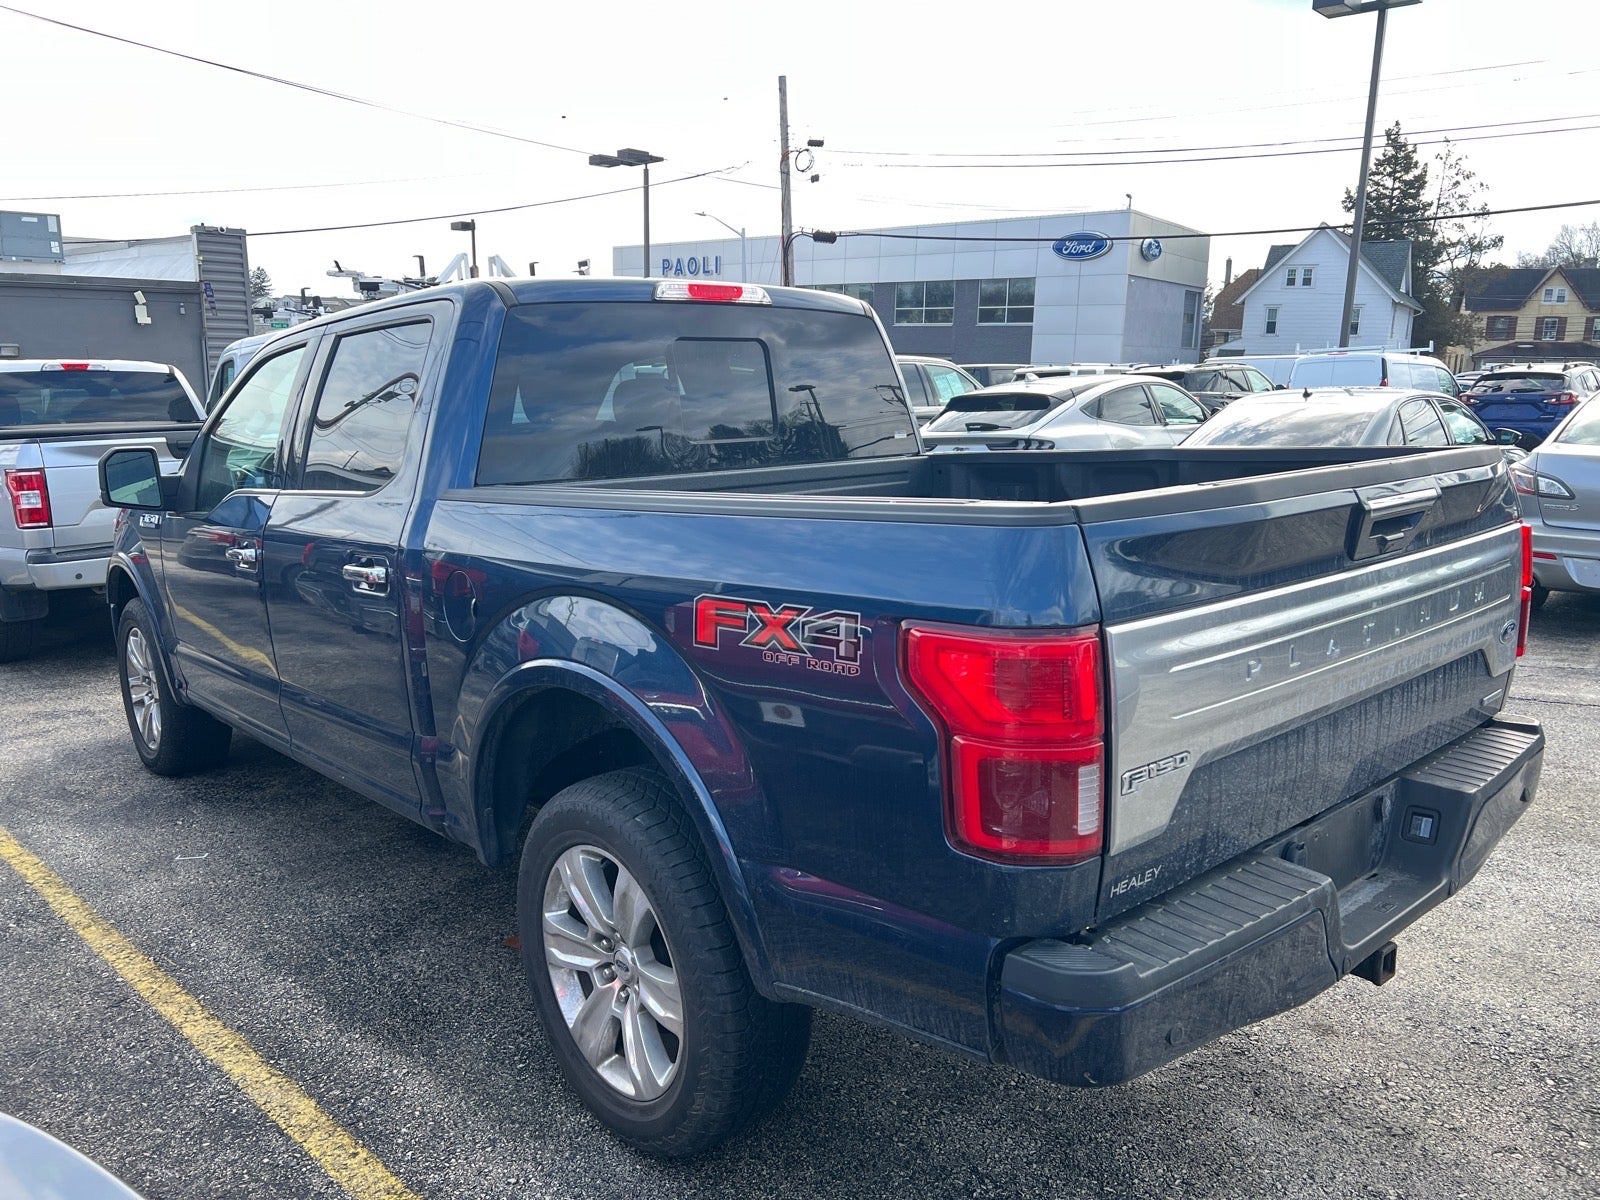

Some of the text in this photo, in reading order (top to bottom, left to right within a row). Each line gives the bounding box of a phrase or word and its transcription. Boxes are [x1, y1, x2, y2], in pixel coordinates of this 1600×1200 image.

[1062, 239, 1096, 254] Ford
[662, 256, 720, 276] PAOLI
[693, 593, 863, 665] FX4
[1246, 582, 1485, 682] PLATINUM
[762, 651, 861, 676] OFF ROAD
[1110, 864, 1162, 898] HEALEY
